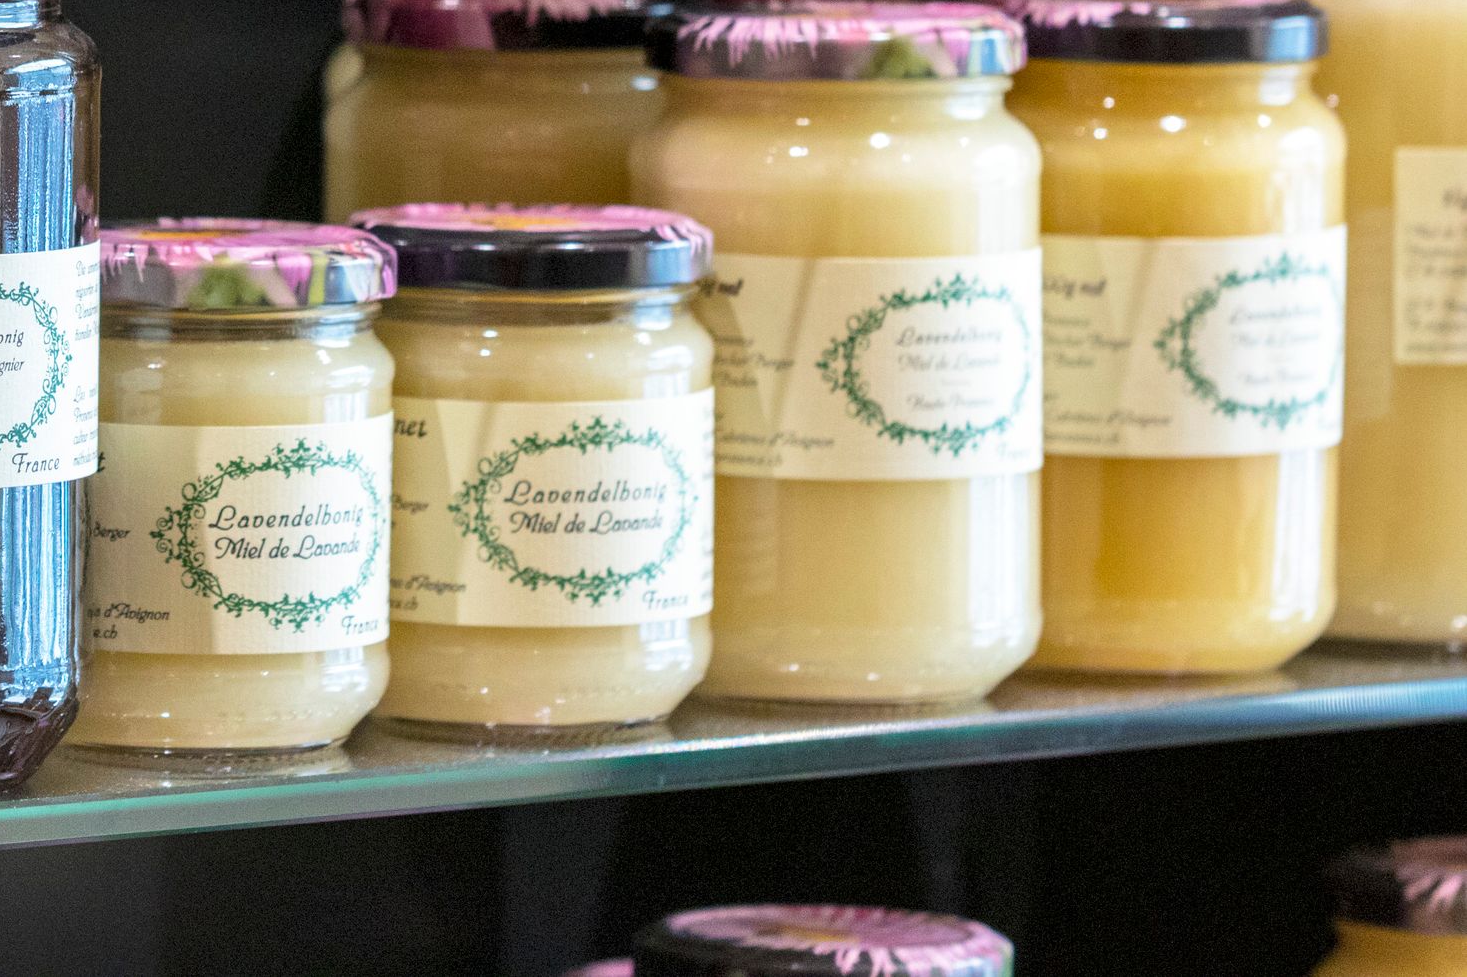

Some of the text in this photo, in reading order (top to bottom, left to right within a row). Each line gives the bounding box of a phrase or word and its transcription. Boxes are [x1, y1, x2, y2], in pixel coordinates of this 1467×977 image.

[11, 451, 61, 474] France
[503, 478, 668, 506] Lavendelhonig
[208, 504, 364, 531] Lavendelhonig
[508, 511, 558, 534] Miel
[563, 512, 586, 534] de
[214, 534, 360, 560] Miel de Lavande
